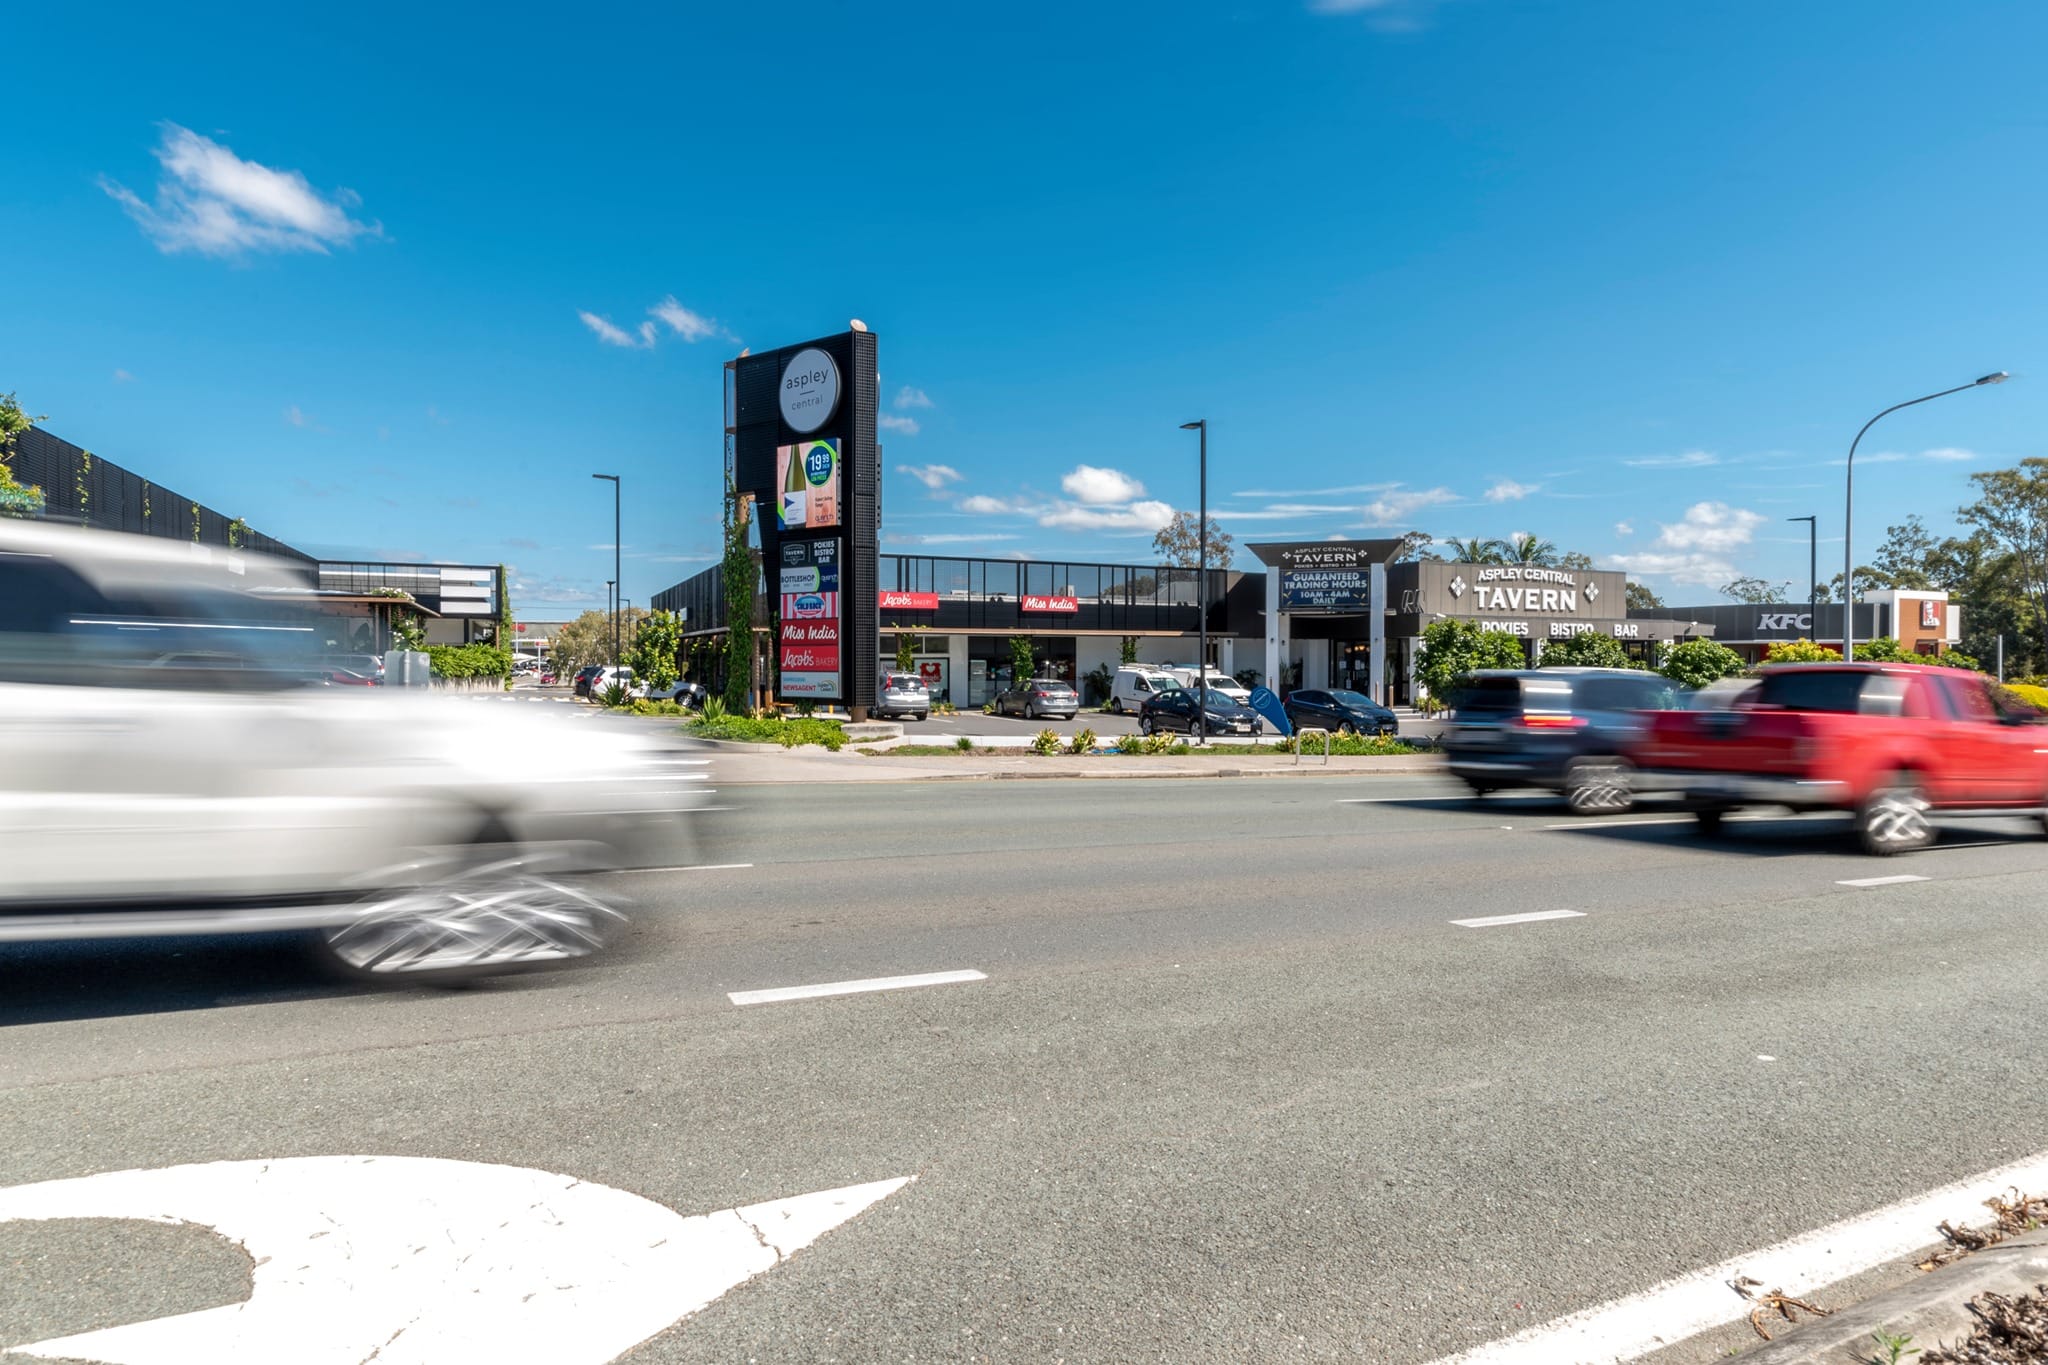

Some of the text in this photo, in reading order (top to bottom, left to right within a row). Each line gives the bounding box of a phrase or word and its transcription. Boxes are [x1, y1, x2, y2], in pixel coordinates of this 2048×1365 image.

[786, 369, 829, 389] aspley
[791, 395, 823, 410] central
[813, 540, 835, 549] POKIES
[814, 548, 835, 557] BISTRO
[1293, 553, 1357, 563] TAVERN
[818, 556, 831, 564] BAR
[781, 574, 815, 583] BOTTLESHOP
[1293, 572, 1360, 582] GUARANTEED
[1478, 568, 1576, 586] ASPLEY CENTRAL
[1284, 580, 1367, 590] TRADING HOURS
[882, 593, 912, 607] Jacob's
[1024, 597, 1075, 610] Miss India
[1313, 597, 1336, 605] DAILY
[1473, 585, 1577, 611] TAVERN
[1756, 613, 1812, 630] KFC
[782, 624, 838, 640] Miss India
[1481, 621, 1639, 637] POKIES BISTRO BAR
[781, 648, 838, 668] Jacob's BAKERY
[783, 684, 816, 692] NEWSAGENT
